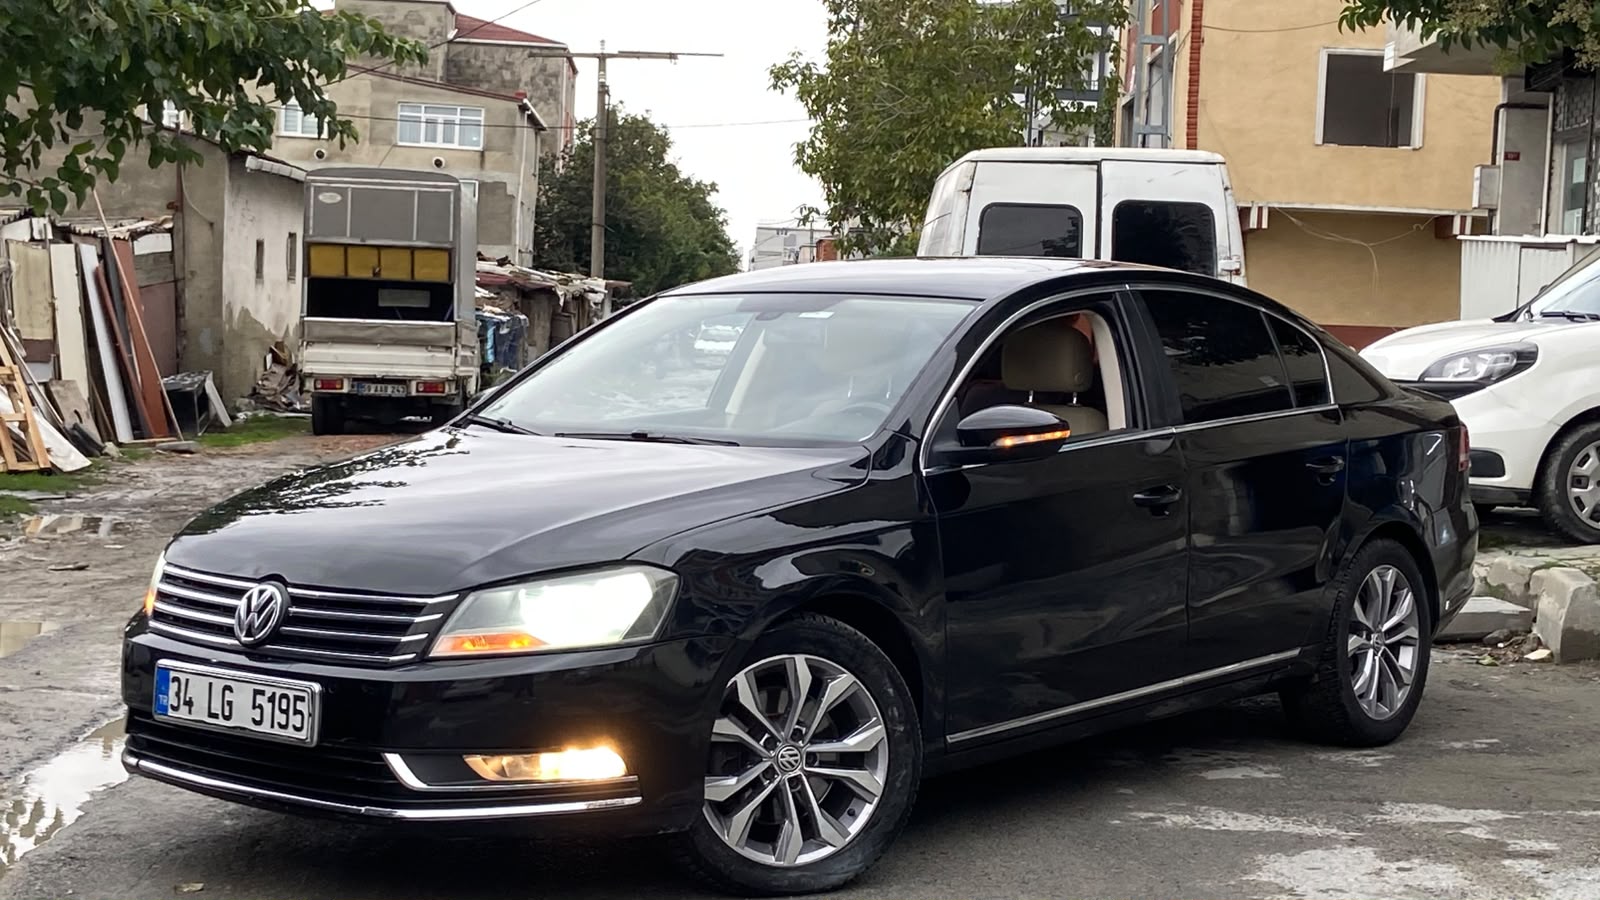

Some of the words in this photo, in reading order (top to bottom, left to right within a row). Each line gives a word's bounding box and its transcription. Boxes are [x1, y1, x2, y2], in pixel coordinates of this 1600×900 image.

[169, 676, 194, 715] 34
[207, 681, 234, 721] LG
[251, 688, 306, 732] 5195
